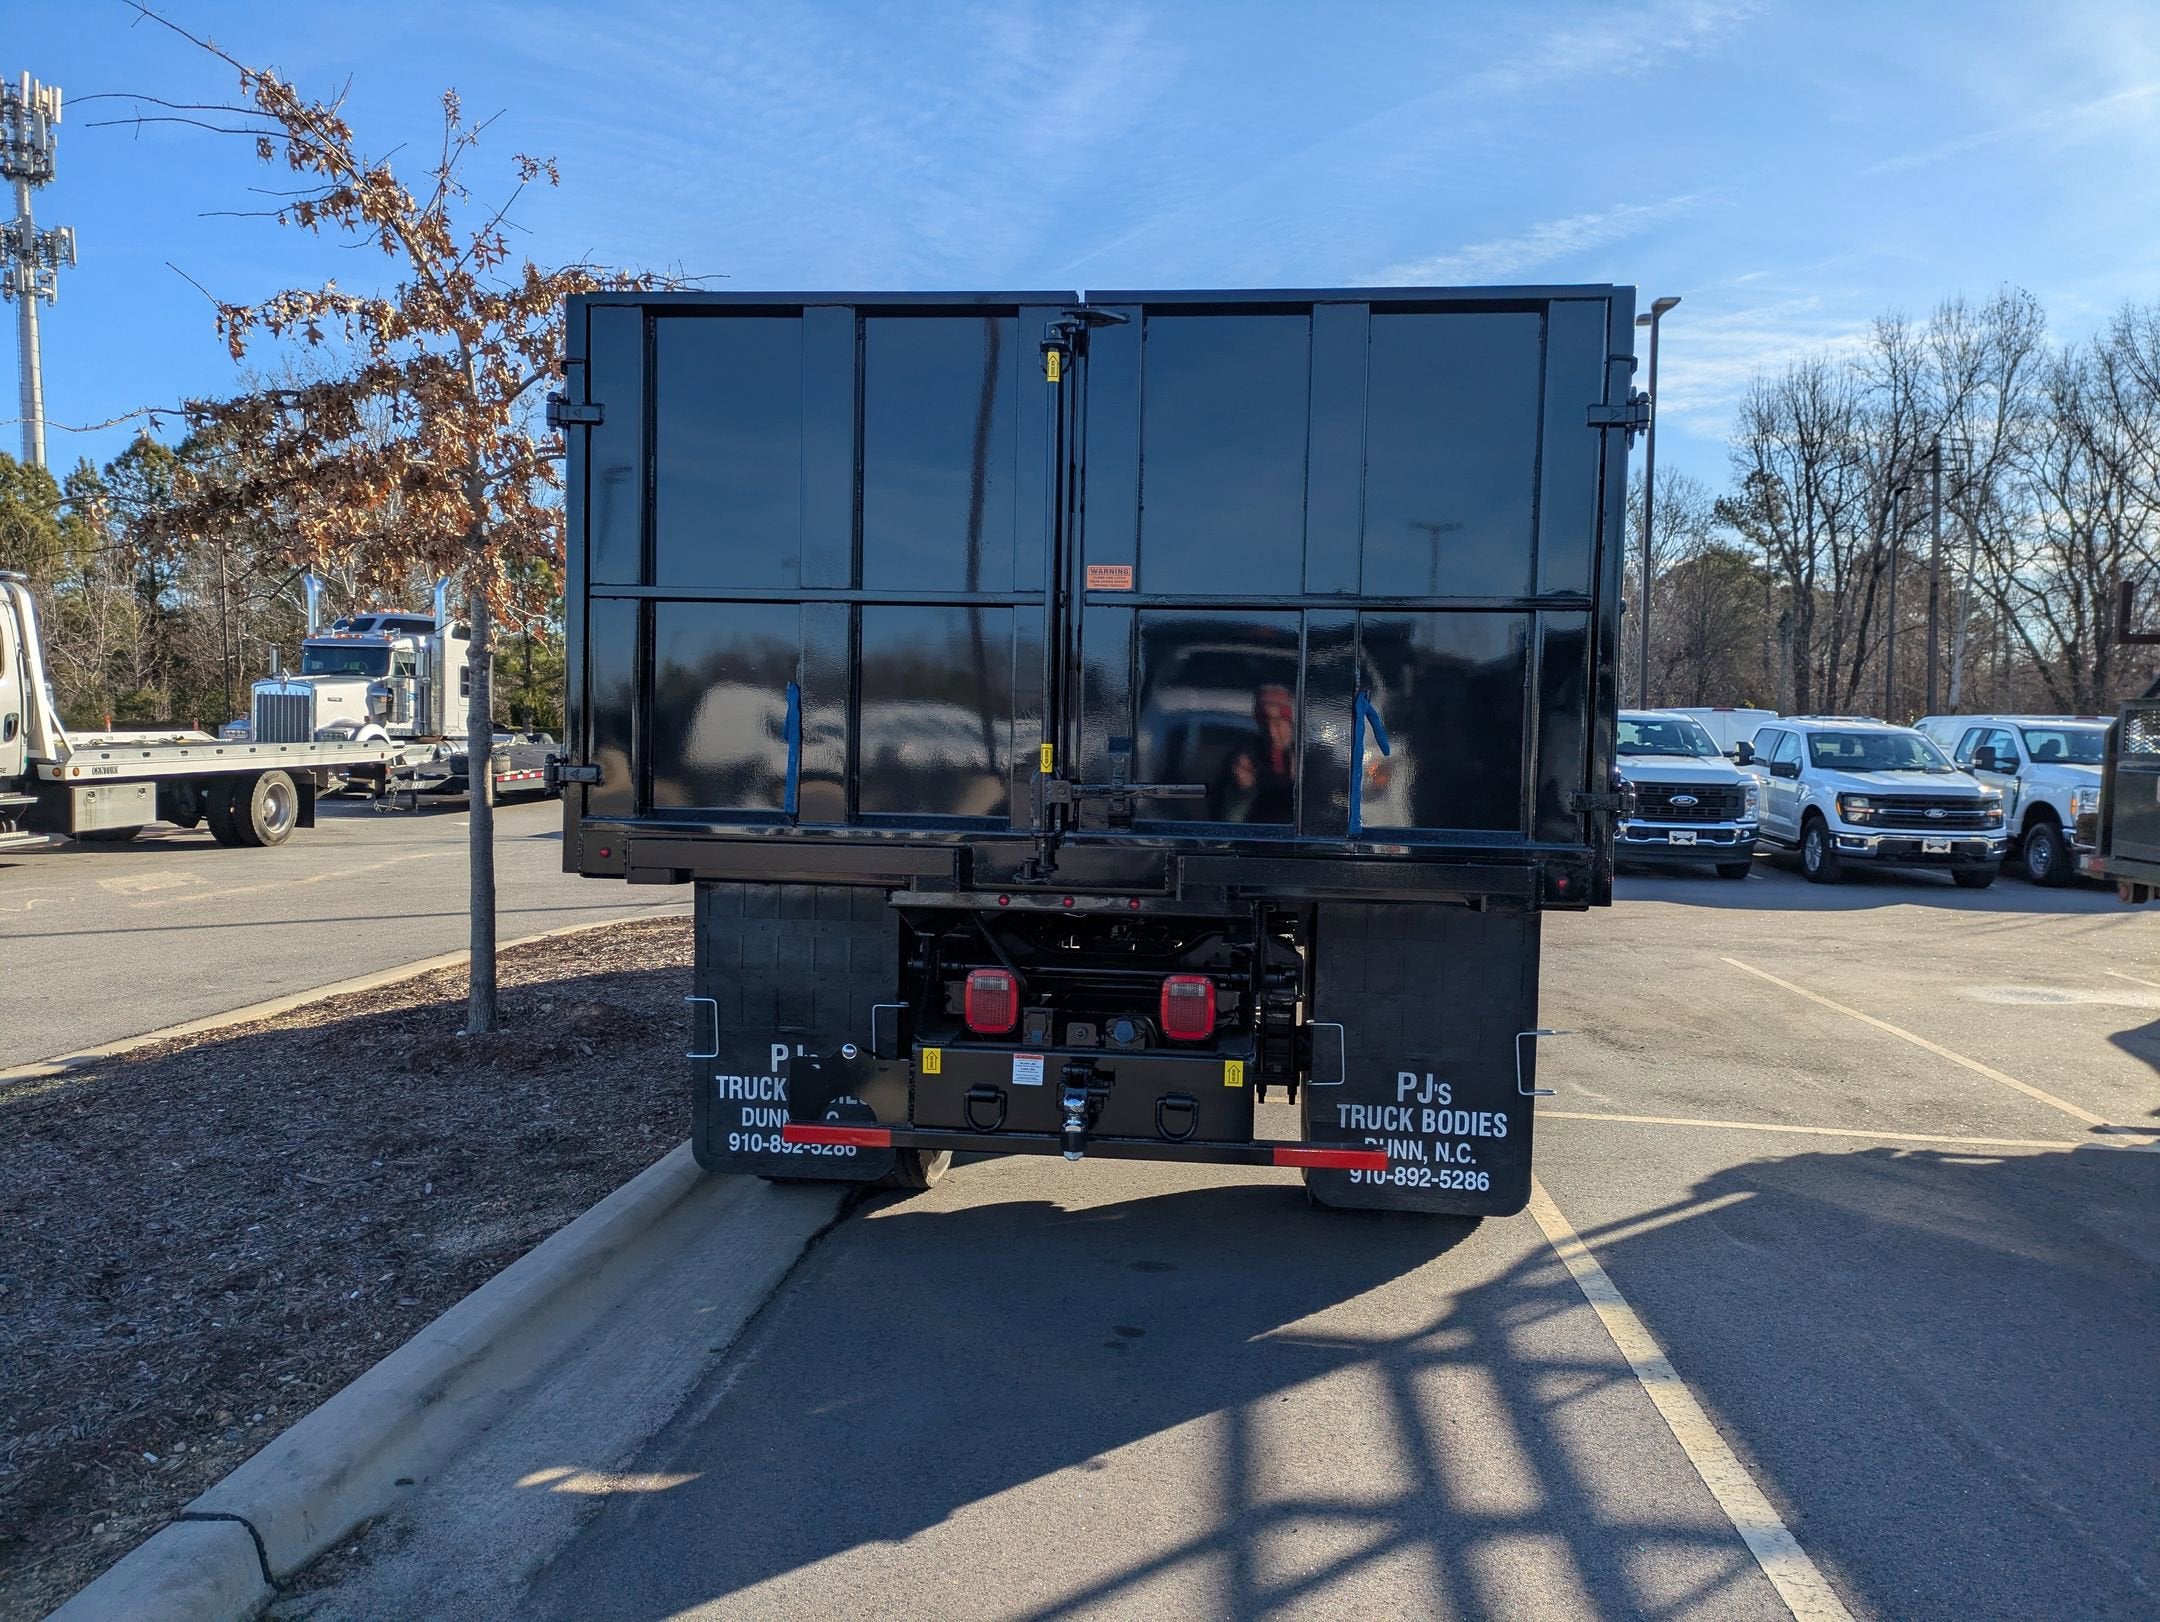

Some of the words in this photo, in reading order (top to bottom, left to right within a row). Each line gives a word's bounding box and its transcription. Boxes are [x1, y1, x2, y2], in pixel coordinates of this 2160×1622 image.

[715, 1075, 787, 1101] TRUCK
[1397, 1072, 1452, 1105] PJ's
[1336, 1104, 1414, 1132] TRUCK
[1421, 1109, 1508, 1138] BODIES
[1435, 1142, 1477, 1164] N.C.
[1350, 1166, 1490, 1192] 910-892-5286
